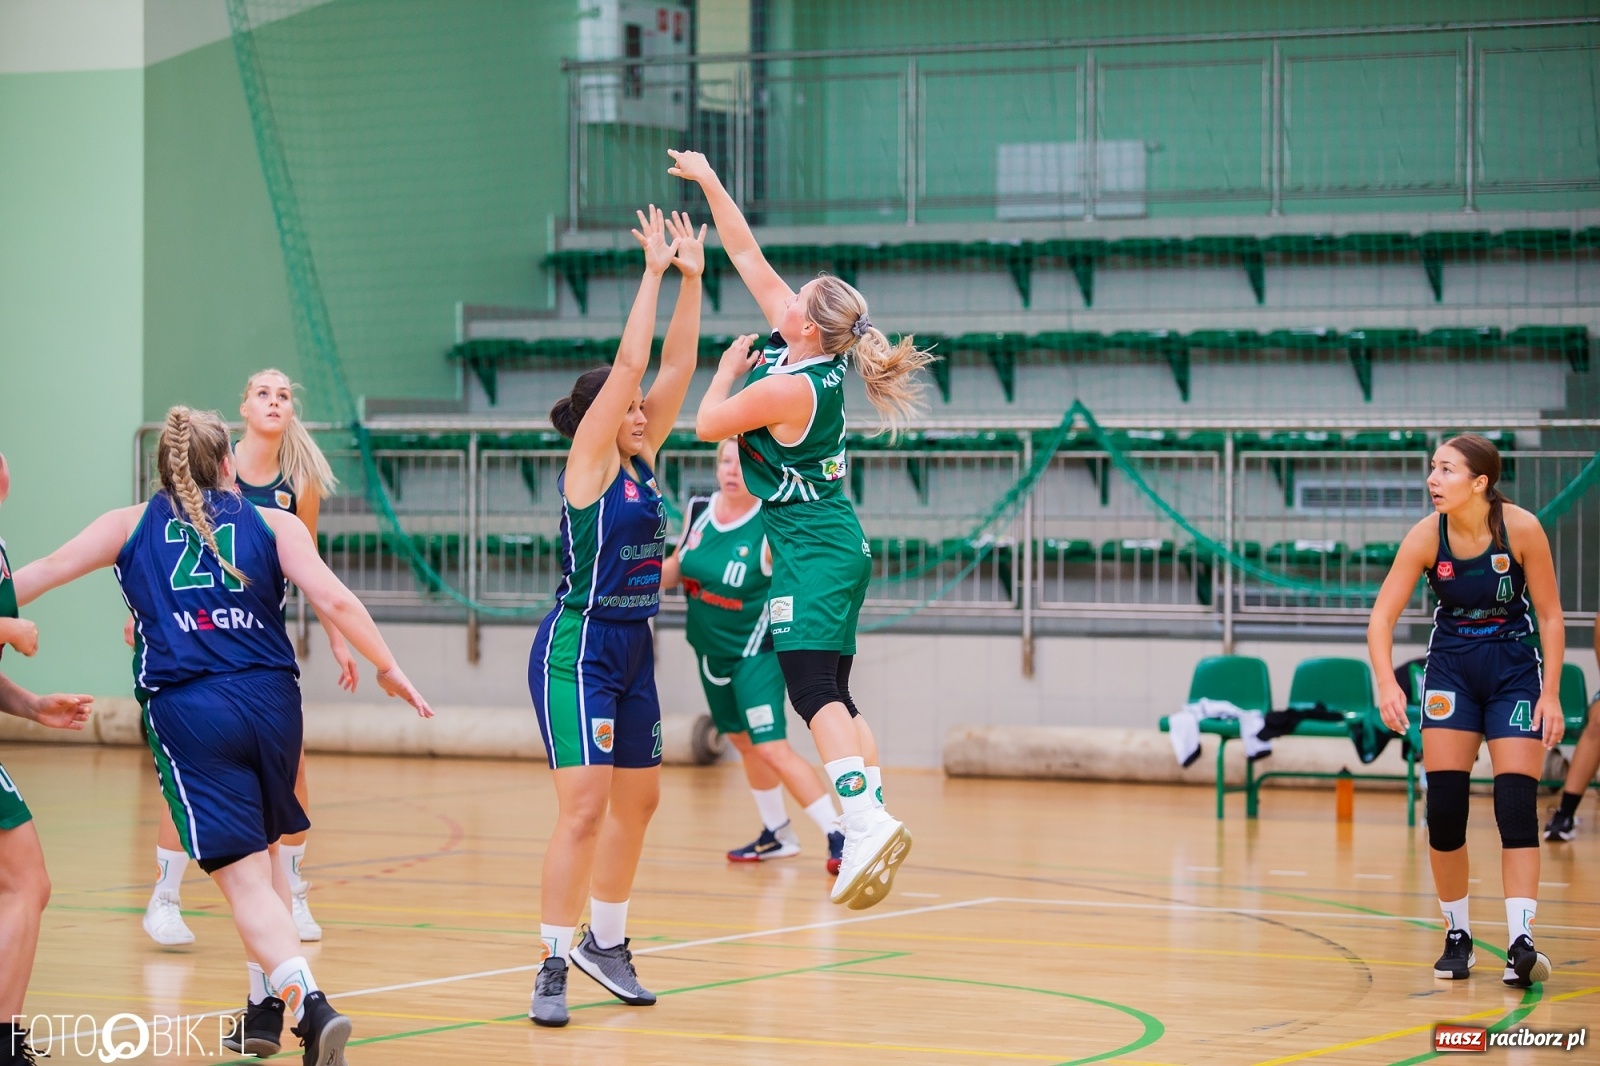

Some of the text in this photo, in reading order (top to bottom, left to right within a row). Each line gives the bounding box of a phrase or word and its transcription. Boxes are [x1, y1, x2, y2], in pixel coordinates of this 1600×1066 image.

[165, 518, 244, 592] 21
[722, 560, 747, 588] 10
[1496, 575, 1515, 603] 4
[1509, 700, 1533, 731] 4
